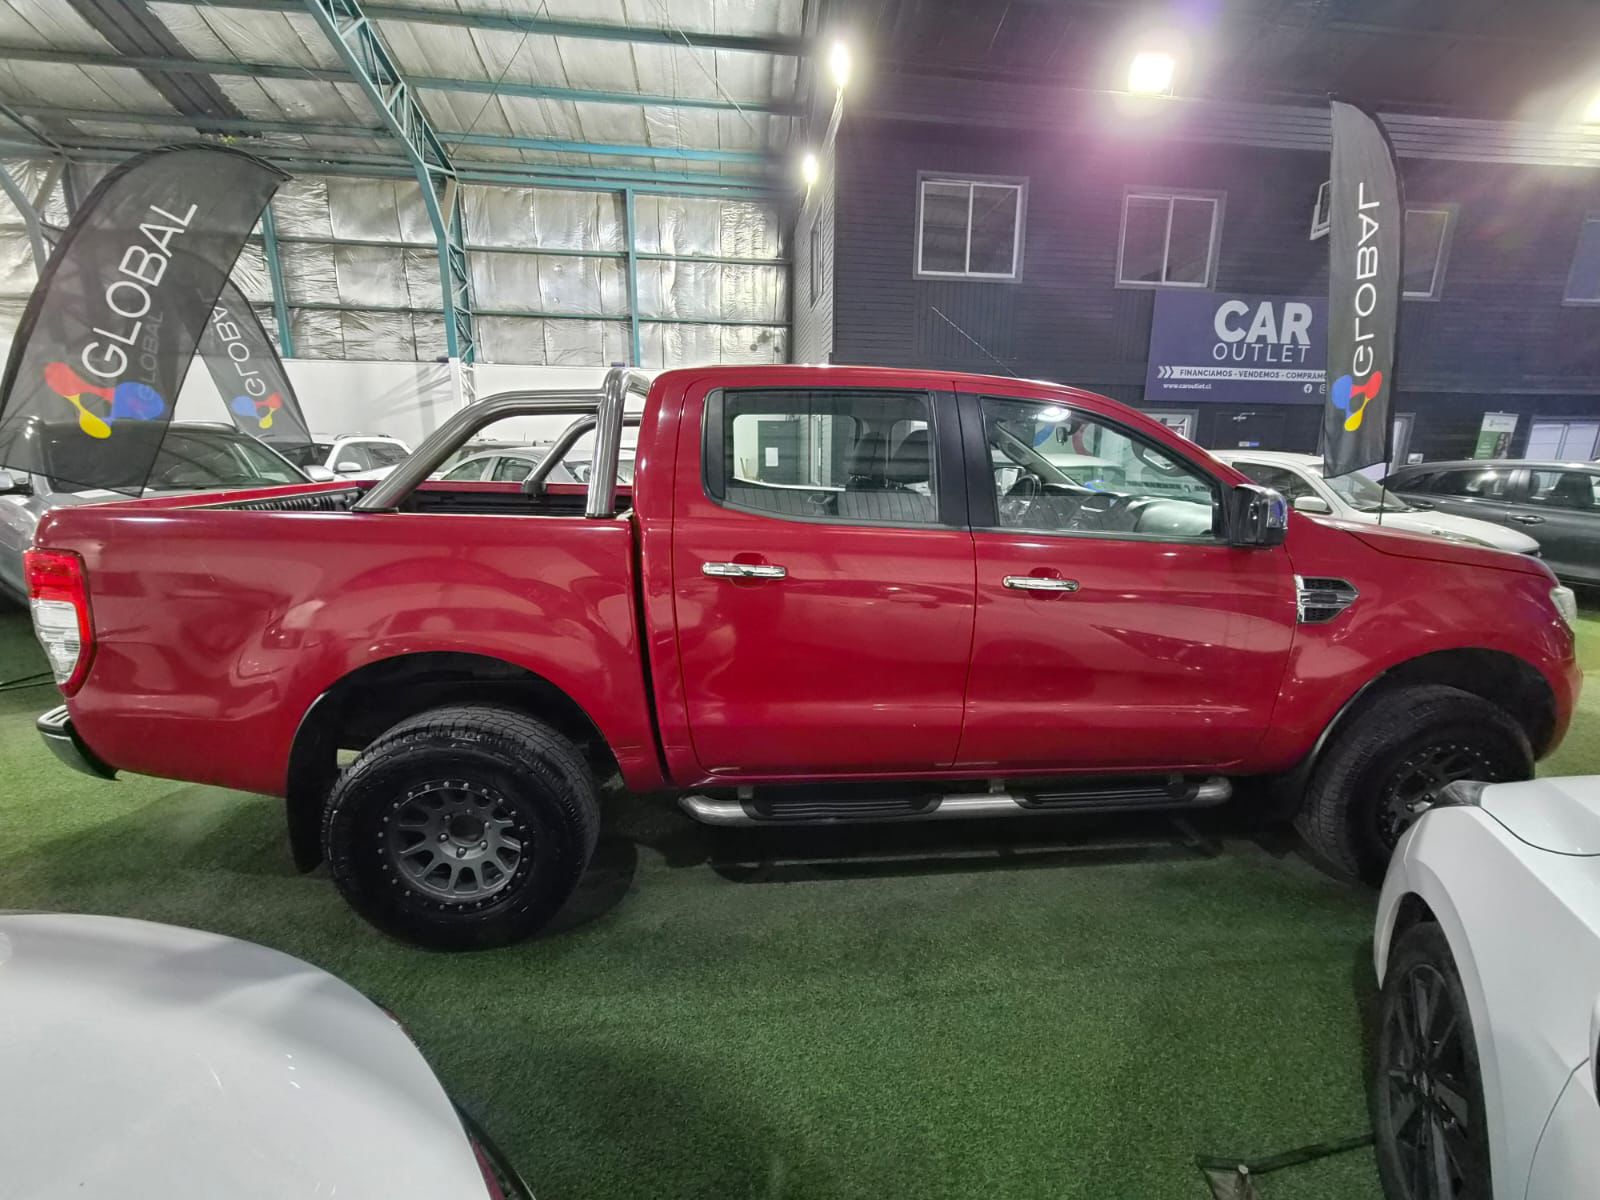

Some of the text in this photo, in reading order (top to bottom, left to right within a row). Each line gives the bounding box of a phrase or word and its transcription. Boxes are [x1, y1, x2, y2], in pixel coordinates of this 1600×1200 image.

[81, 203, 198, 378] GLOBAL
[1214, 300, 1313, 345] CAR
[1213, 342, 1311, 363] OUTLET
[1179, 369, 1233, 378] FINANCIAMOS
[1238, 370, 1280, 379] VENDEMOS
